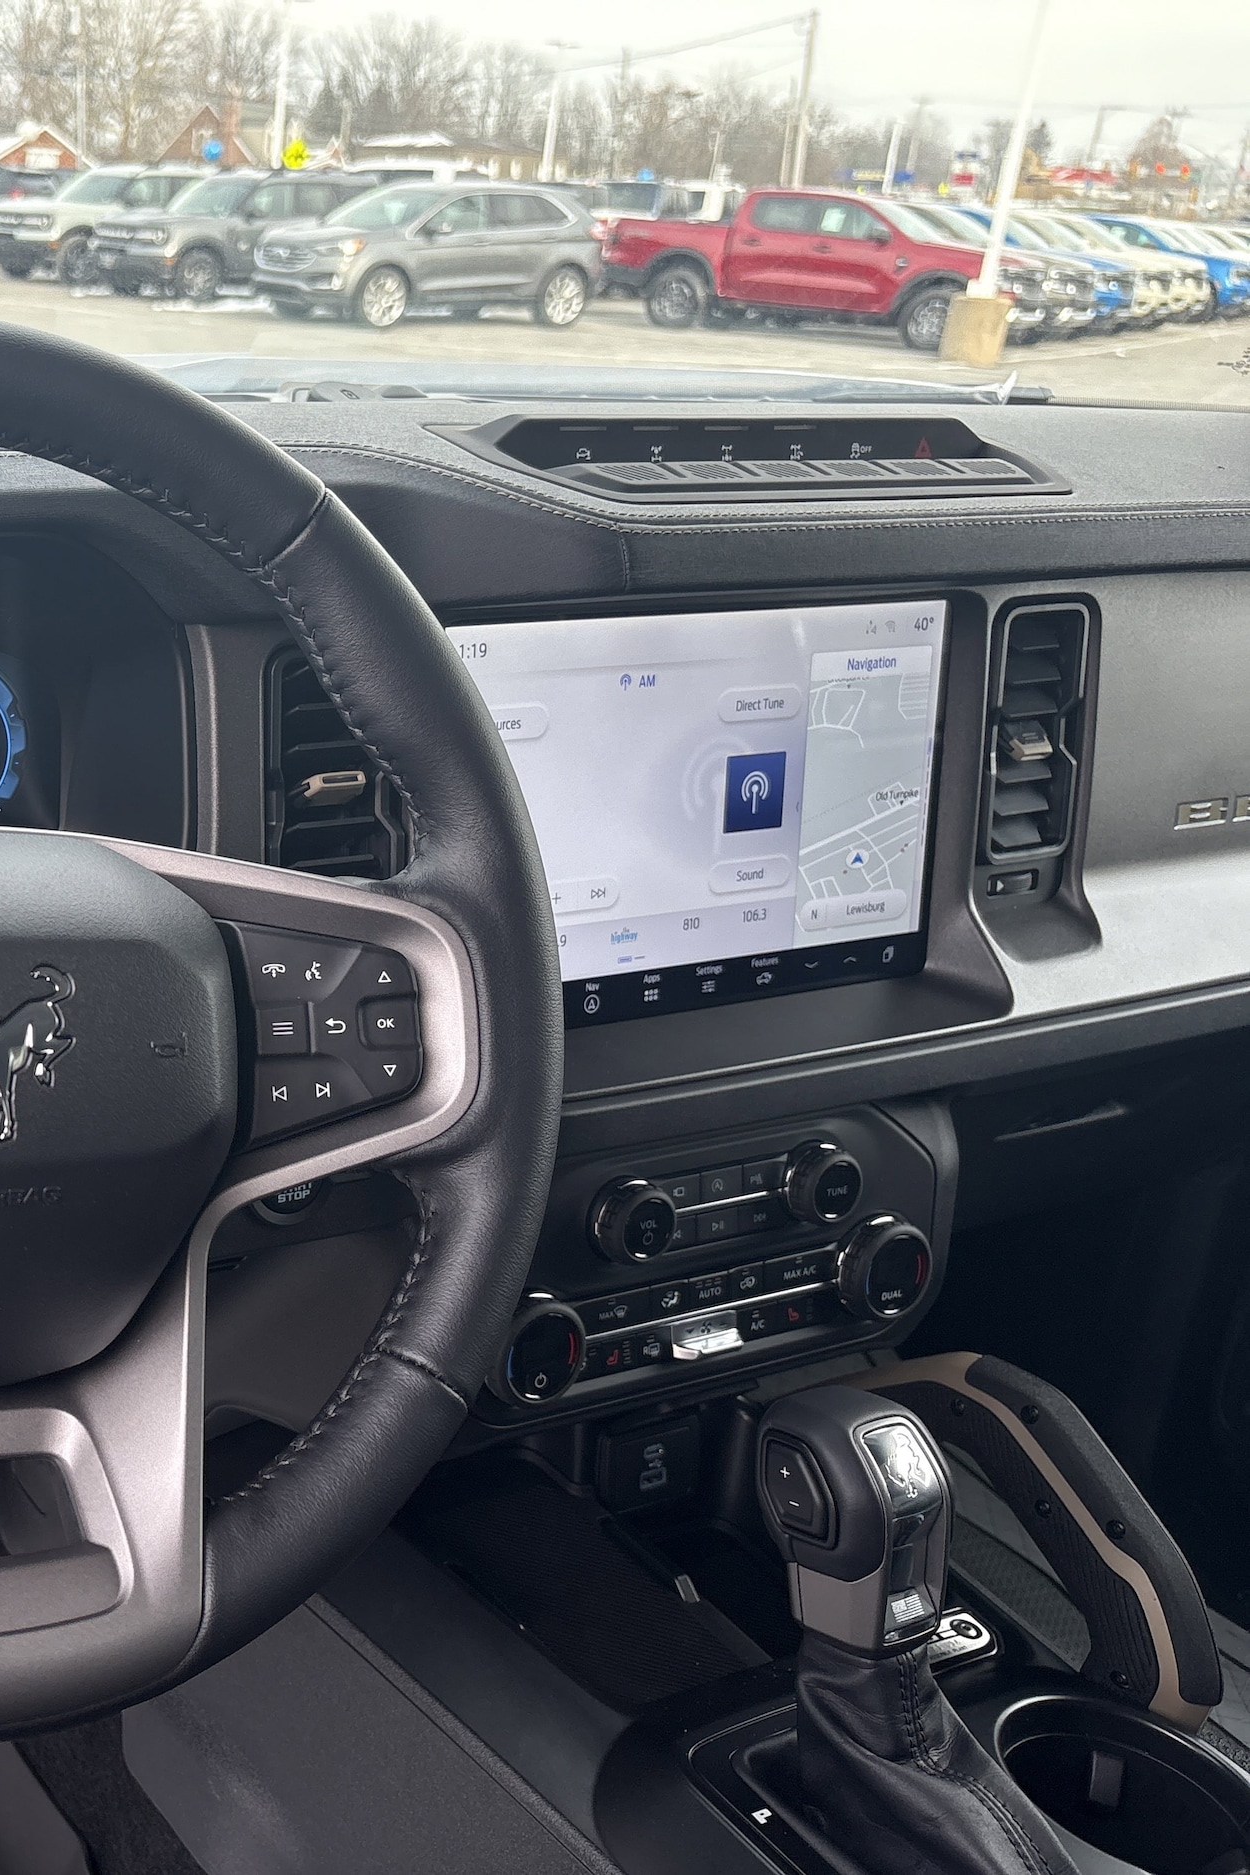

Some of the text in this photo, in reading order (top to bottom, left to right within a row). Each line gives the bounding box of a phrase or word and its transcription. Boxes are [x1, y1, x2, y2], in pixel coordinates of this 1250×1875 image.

[860, 445, 873, 454] OFF
[914, 617, 935, 631] 40°
[847, 656, 897, 672] Navigation
[638, 674, 656, 688] AM
[735, 698, 785, 712] Direct Tune
[495, 717, 522, 731] urces
[875, 788, 919, 801] Old Turnpike
[736, 867, 764, 882] Sound
[742, 908, 767, 923] 106.3
[811, 901, 886, 920] N Lewisburg
[682, 917, 700, 931] 810
[610, 931, 638, 944] highway
[751, 956, 779, 968] Features
[696, 964, 723, 976] Settings
[643, 973, 661, 984] Apps
[585, 982, 600, 992] Nav
[377, 1018, 395, 1029] OK
[277, 1189, 311, 1204] STOP
[826, 1185, 849, 1197] TUNE
[640, 1220, 657, 1230] VOL
[783, 1265, 817, 1281] MAX A/C
[698, 1287, 722, 1300] AUTO
[881, 1289, 903, 1301] DUAL
[598, 1311, 615, 1320] MAX
[750, 1320, 765, 1331] A/C
[750, 1808, 773, 1825] P
